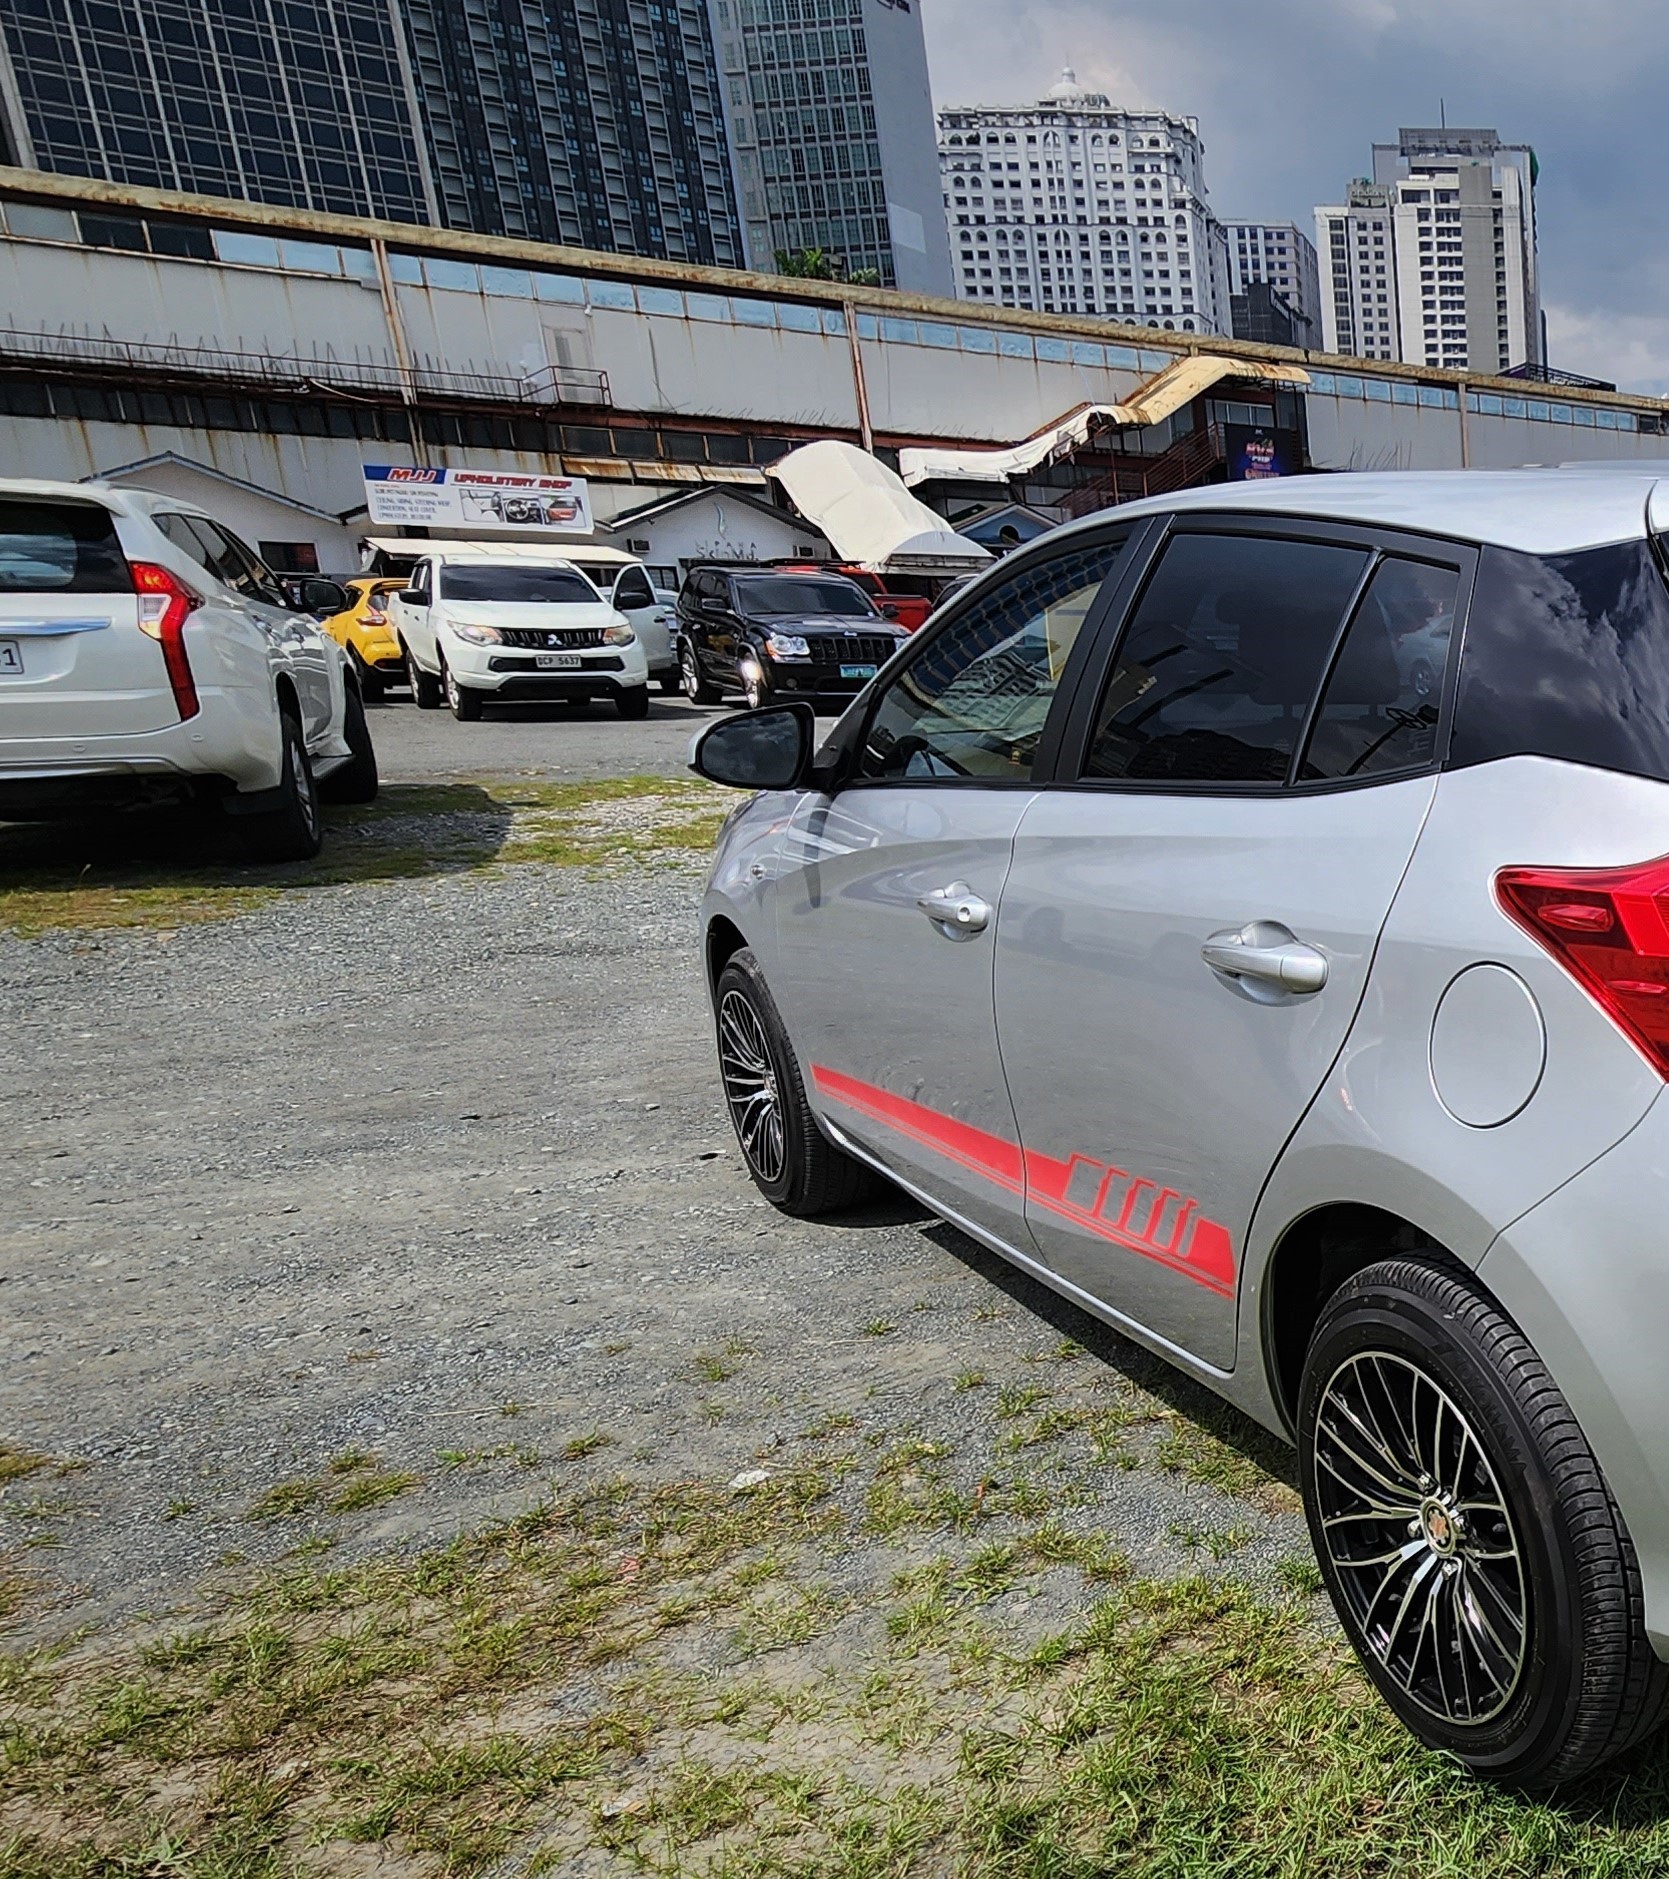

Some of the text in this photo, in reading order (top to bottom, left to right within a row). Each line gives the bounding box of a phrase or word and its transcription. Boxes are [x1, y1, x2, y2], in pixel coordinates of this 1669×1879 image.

[387, 468, 436, 483] MJJ
[454, 473, 537, 487] UPHOLSTERY
[538, 479, 573, 490] SHOP
